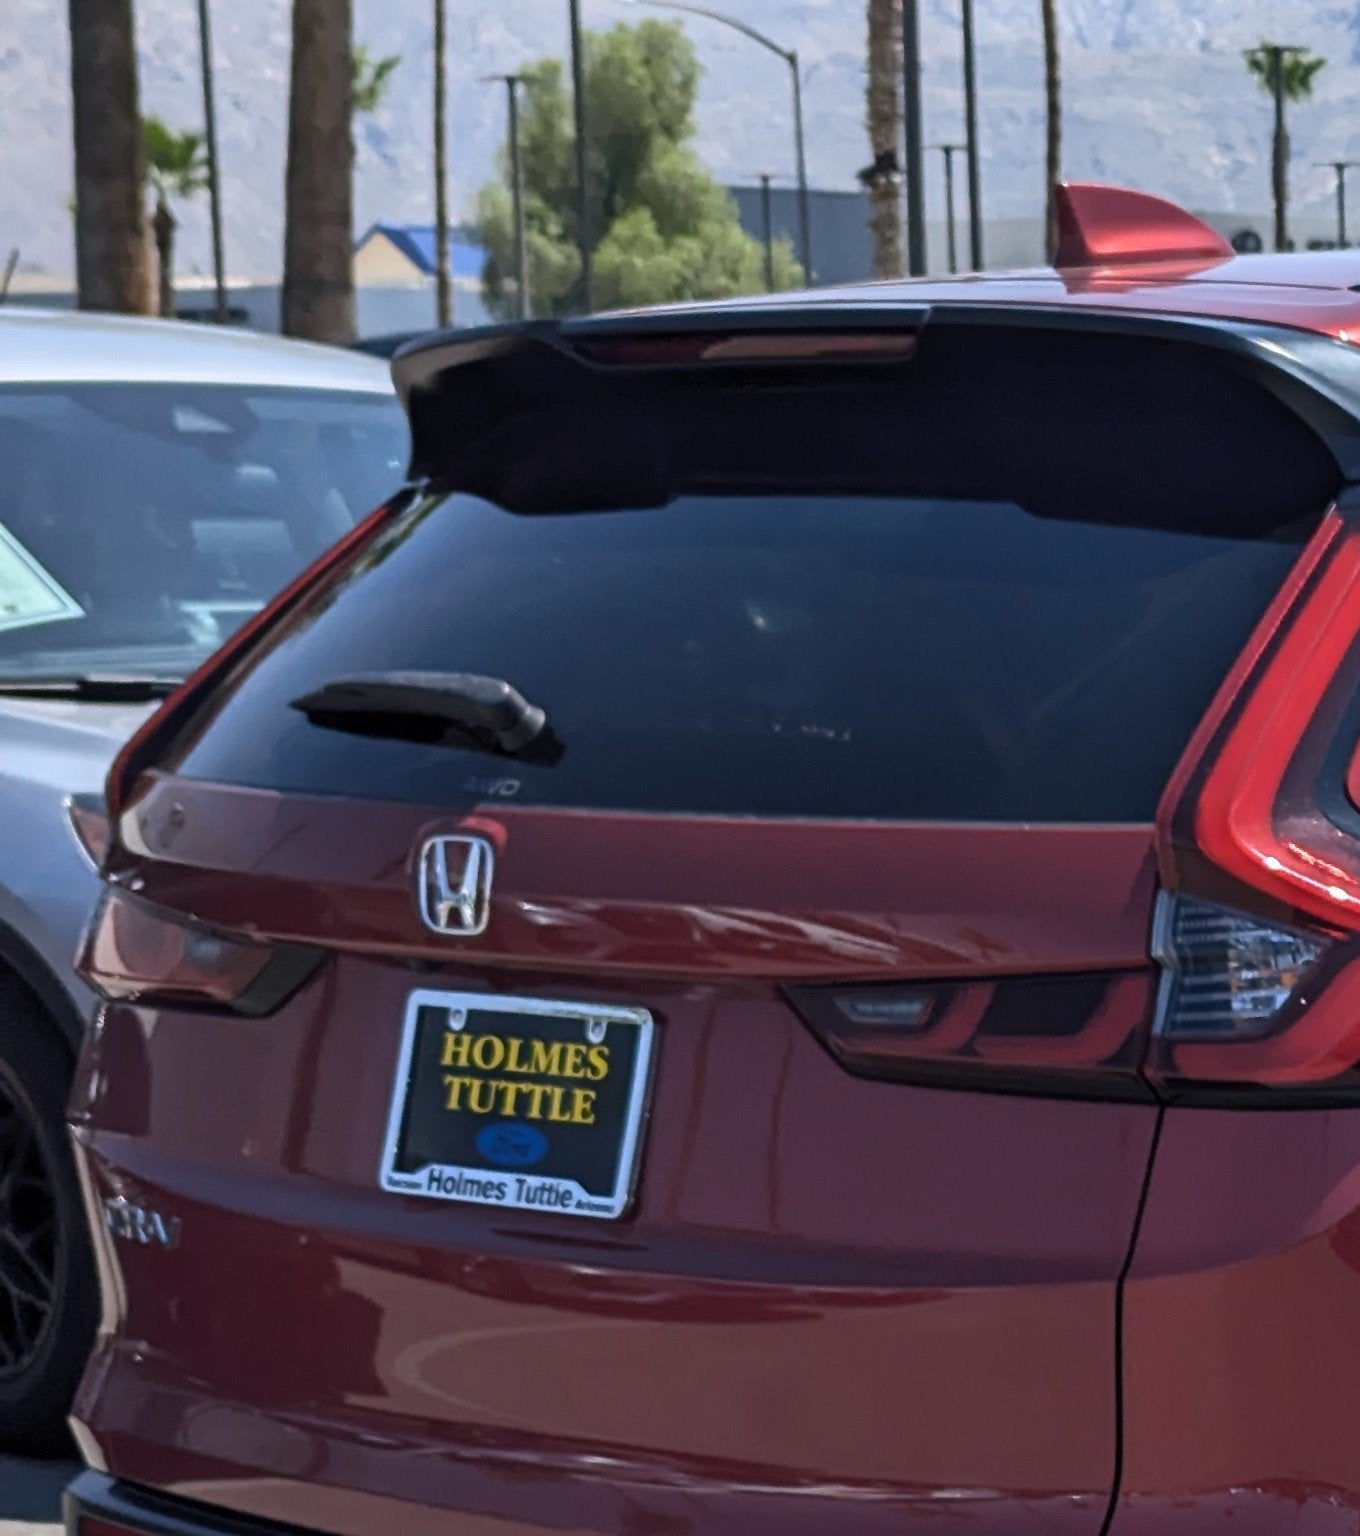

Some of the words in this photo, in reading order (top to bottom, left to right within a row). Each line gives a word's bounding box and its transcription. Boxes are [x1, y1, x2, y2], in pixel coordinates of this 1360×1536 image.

[441, 1032, 610, 1082] HOLMES
[443, 1075, 597, 1125] TUTTLE
[427, 1167, 508, 1202] Holmes
[515, 1177, 574, 1209] Tuttle
